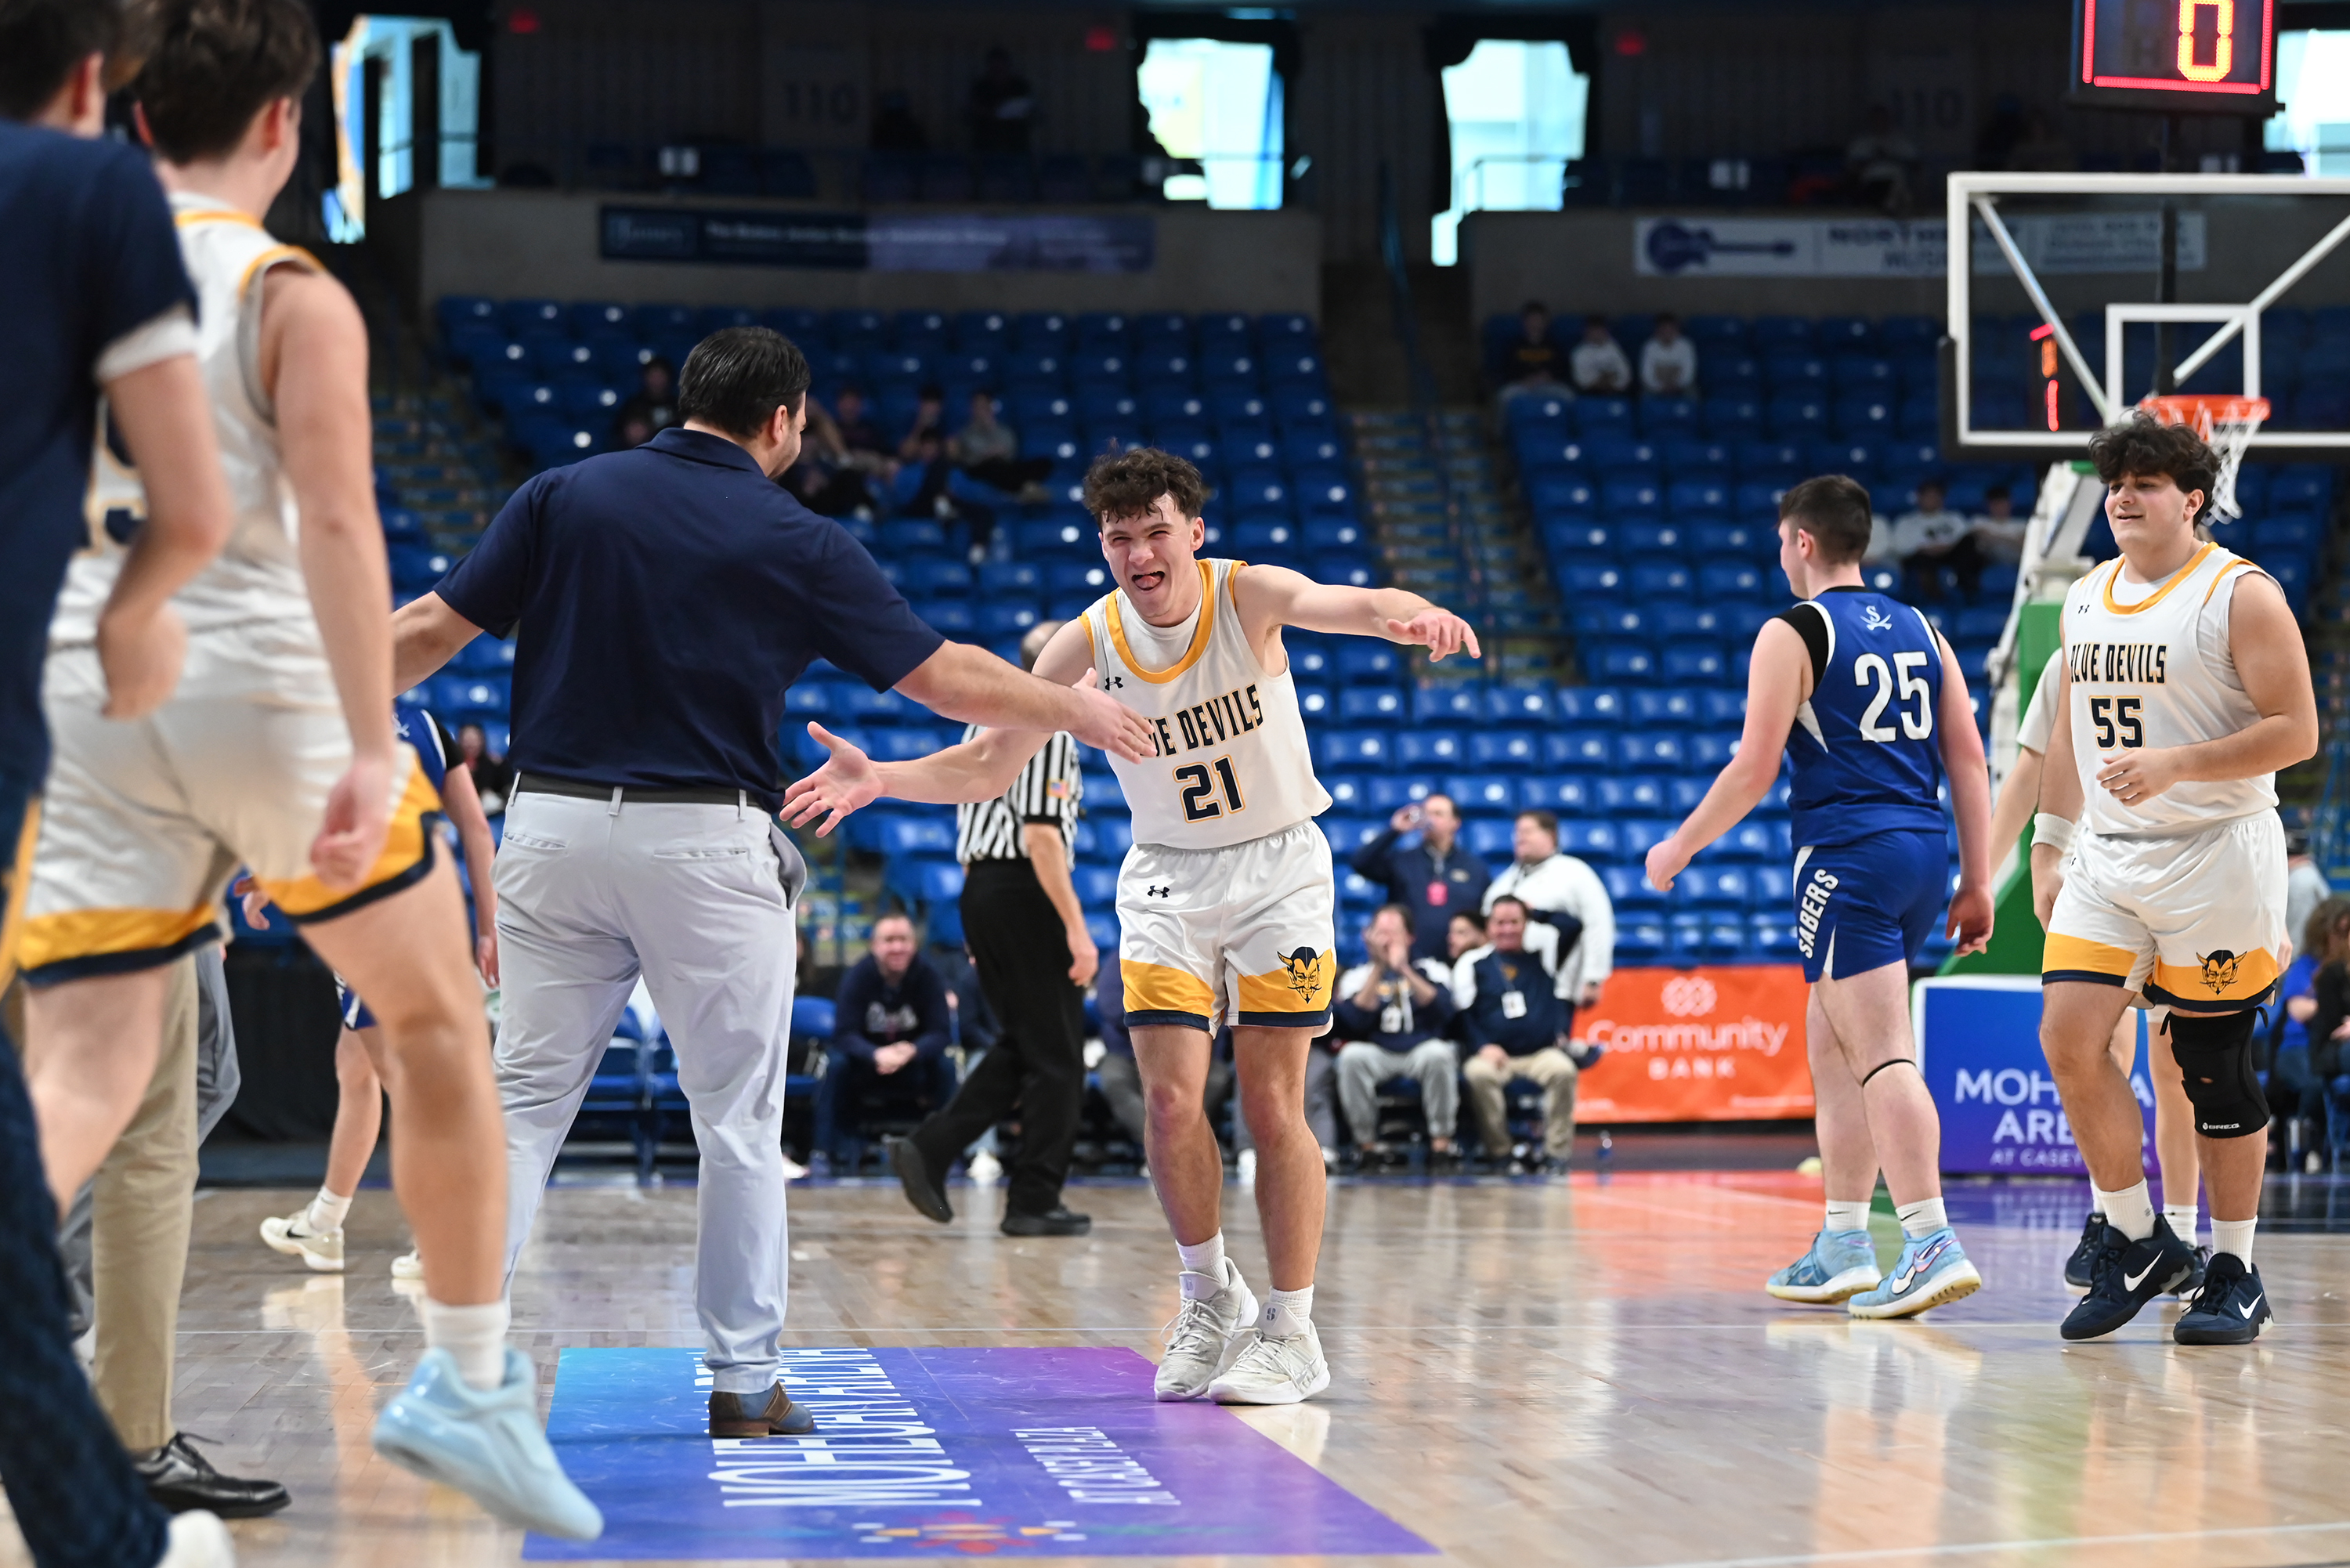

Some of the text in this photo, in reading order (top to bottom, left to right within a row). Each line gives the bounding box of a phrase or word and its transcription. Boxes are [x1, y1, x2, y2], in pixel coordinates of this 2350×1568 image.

[2178, 0, 2233, 81] 0
[2105, 644, 2167, 684] DEVILS
[1140, 683, 1264, 757] UE DEVILS
[1854, 651, 1932, 742] 25
[2090, 697, 2144, 749] 55
[1173, 755, 1245, 822] 21
[1799, 869, 1838, 959] SABERS
[1586, 1015, 1789, 1057] Community
[1648, 1057, 1737, 1080] BANK
[1990, 1148, 2016, 1166] AT
[1009, 1425, 1123, 1454] PLAZA
